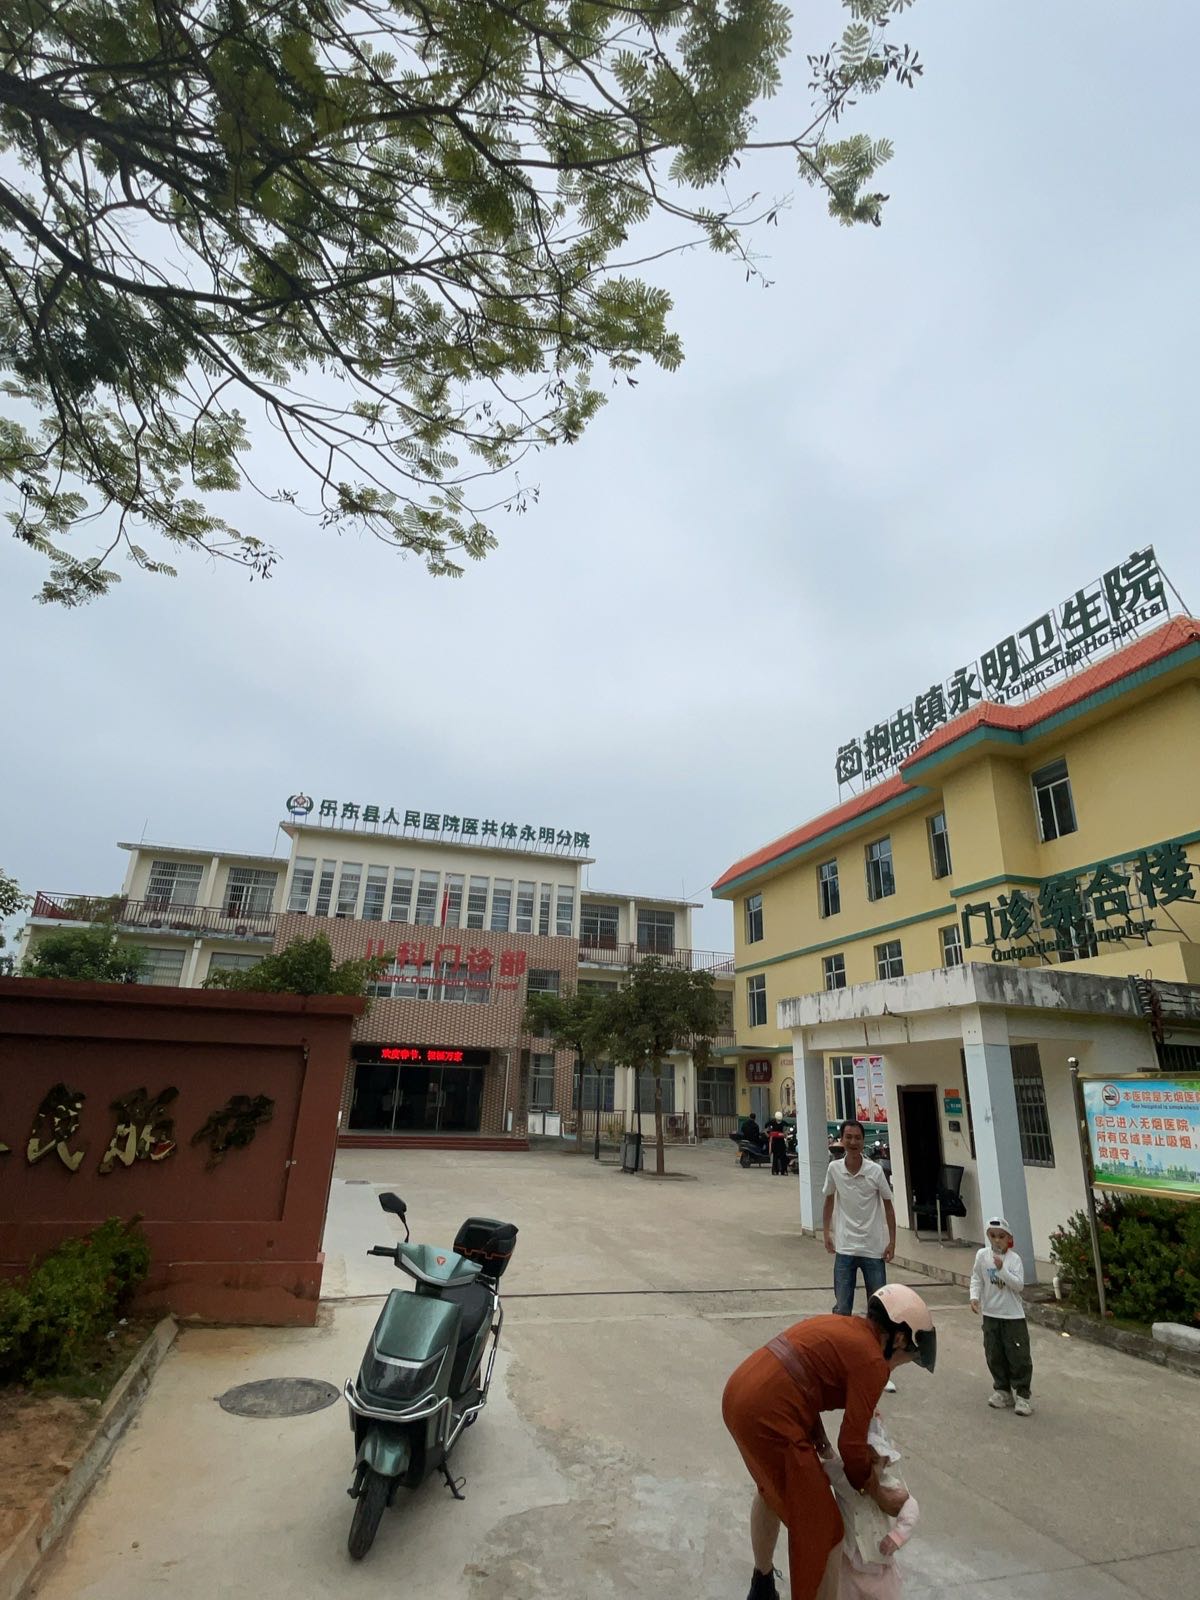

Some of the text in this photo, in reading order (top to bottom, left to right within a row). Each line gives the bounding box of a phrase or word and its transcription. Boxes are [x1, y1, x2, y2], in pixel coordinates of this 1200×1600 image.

[864, 547, 1168, 768] 抱由镇永明卫生院
[319, 799, 591, 849] 乐东县人民医院医共体永明分院
[961, 843, 1197, 949] 门诊综合楼
[364, 938, 527, 976] 儿科门诊部
